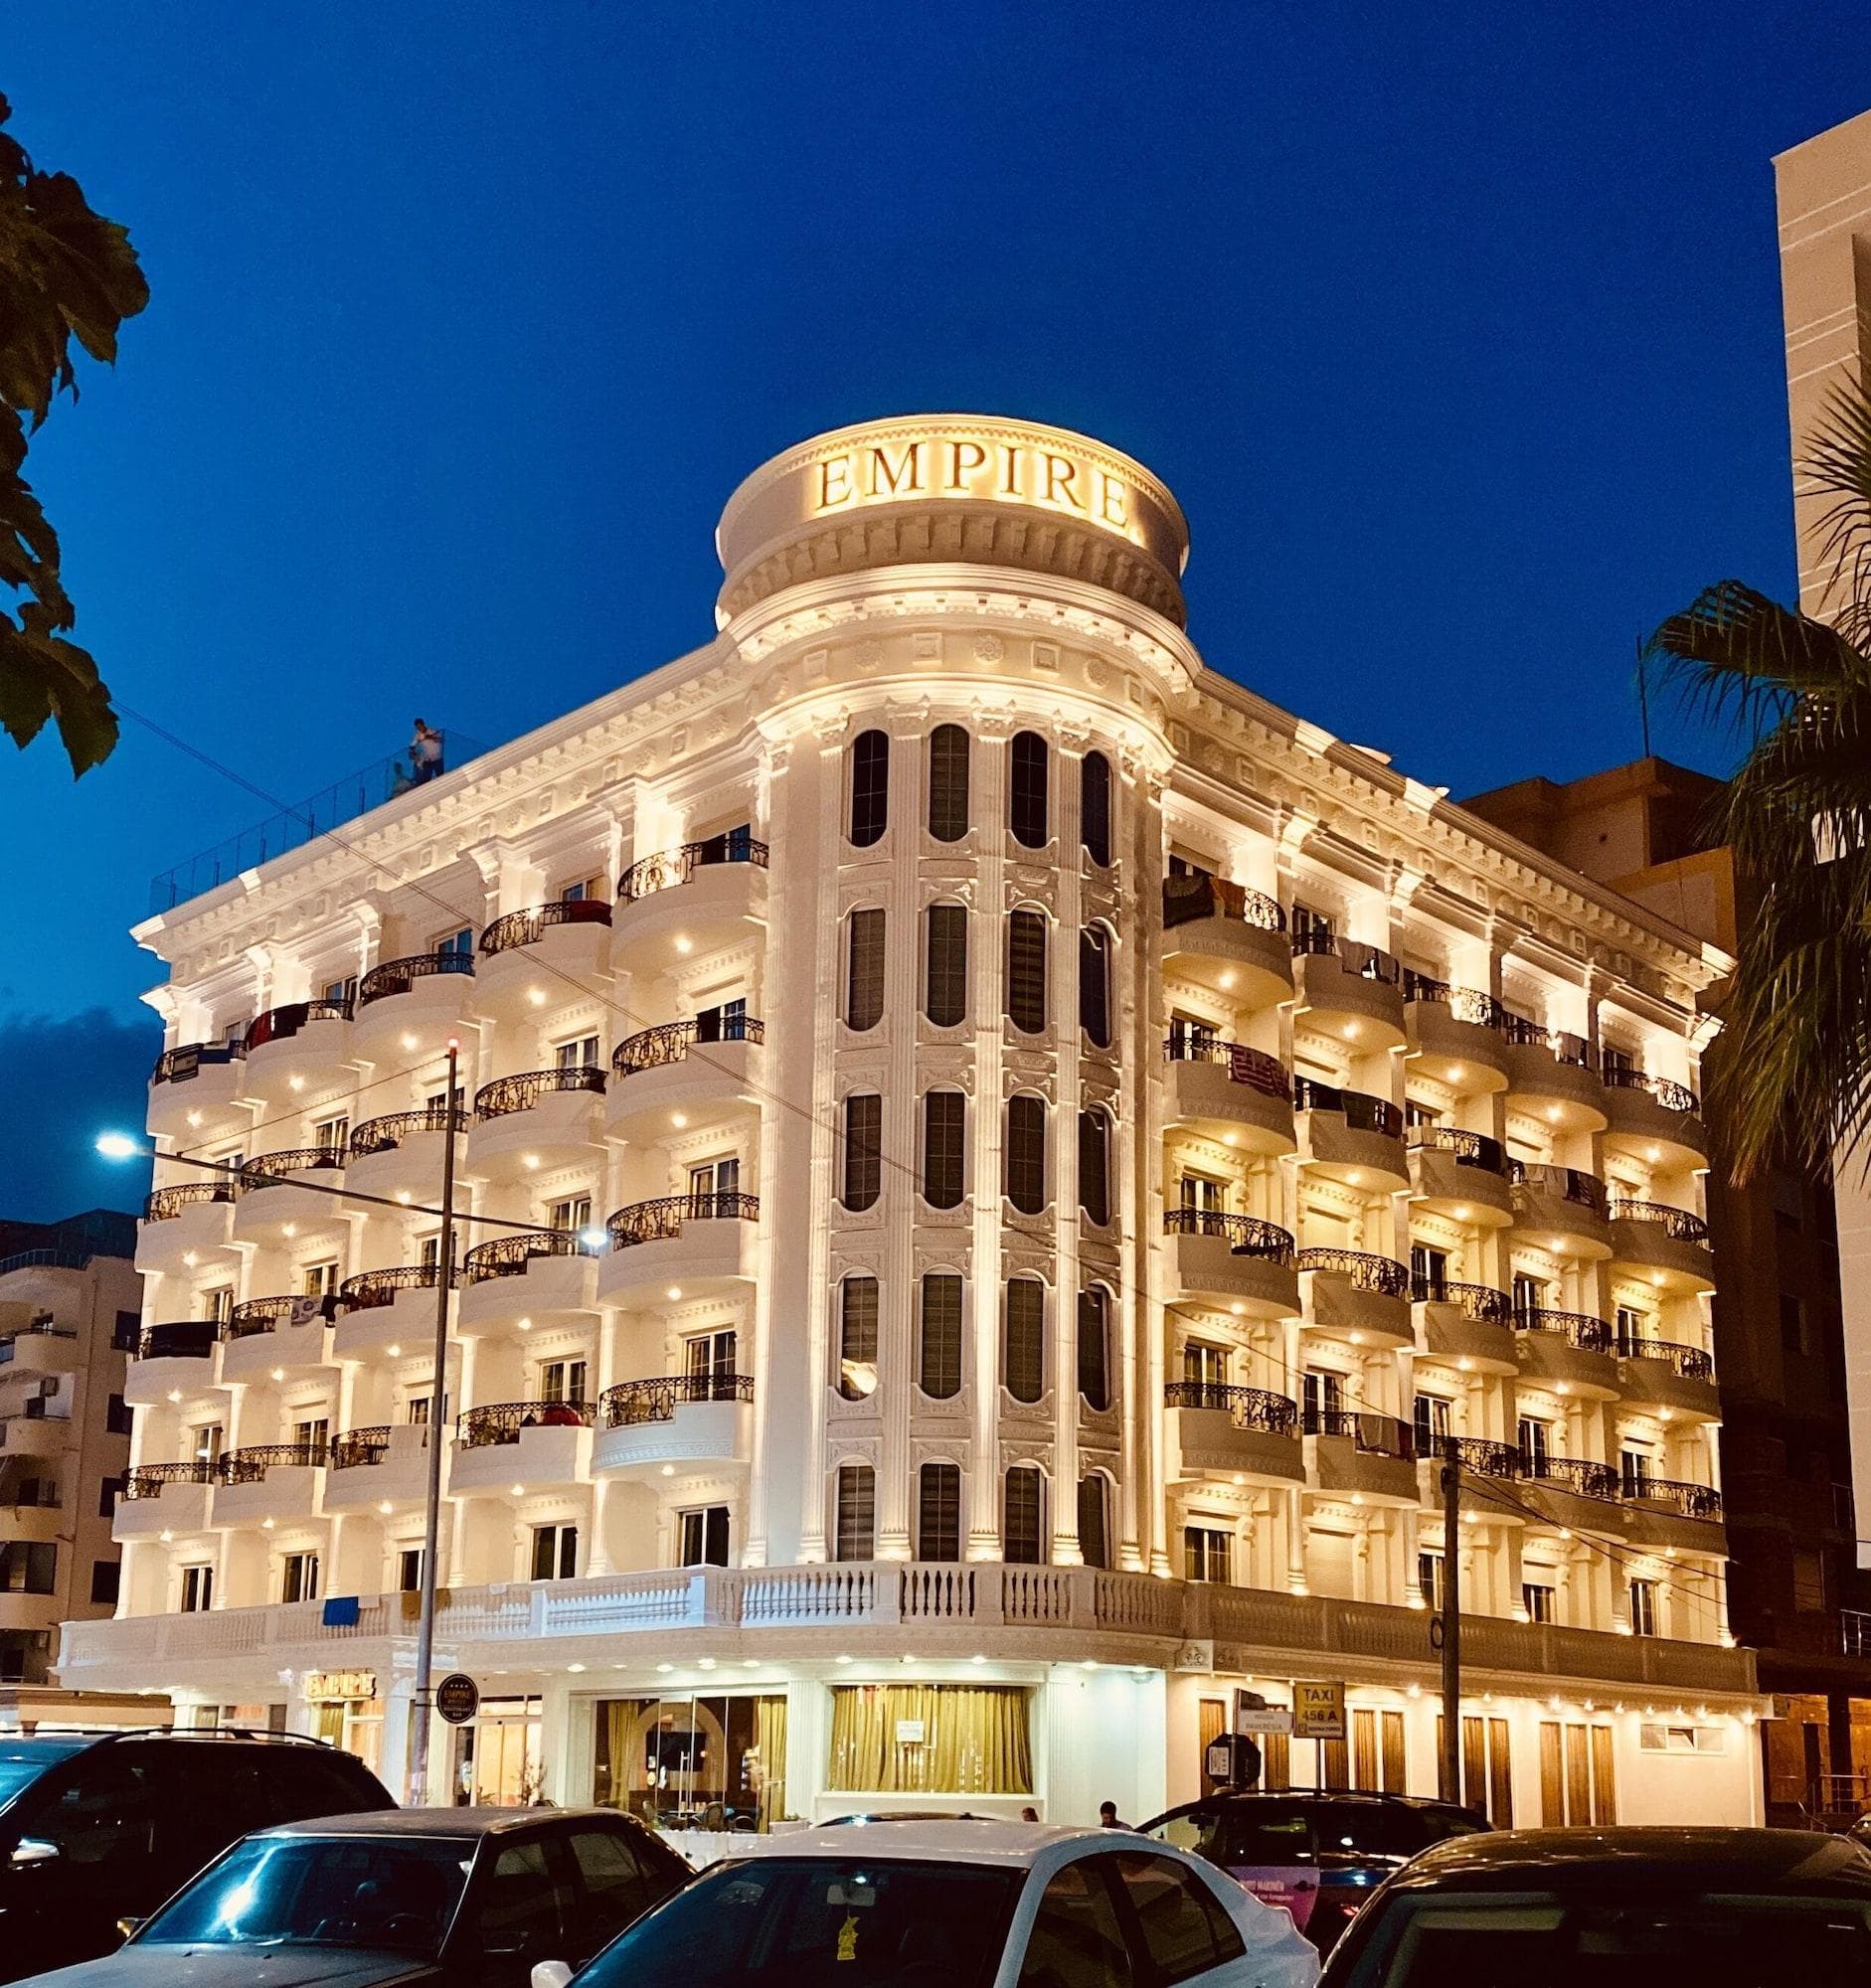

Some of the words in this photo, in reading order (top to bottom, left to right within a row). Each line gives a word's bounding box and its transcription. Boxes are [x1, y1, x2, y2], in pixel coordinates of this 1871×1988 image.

[815, 440, 1129, 527] EMPIRE
[307, 1673, 376, 1698] EMPIRE
[1302, 1688, 1334, 1702] TAXI
[1301, 1710, 1324, 1721] 456
